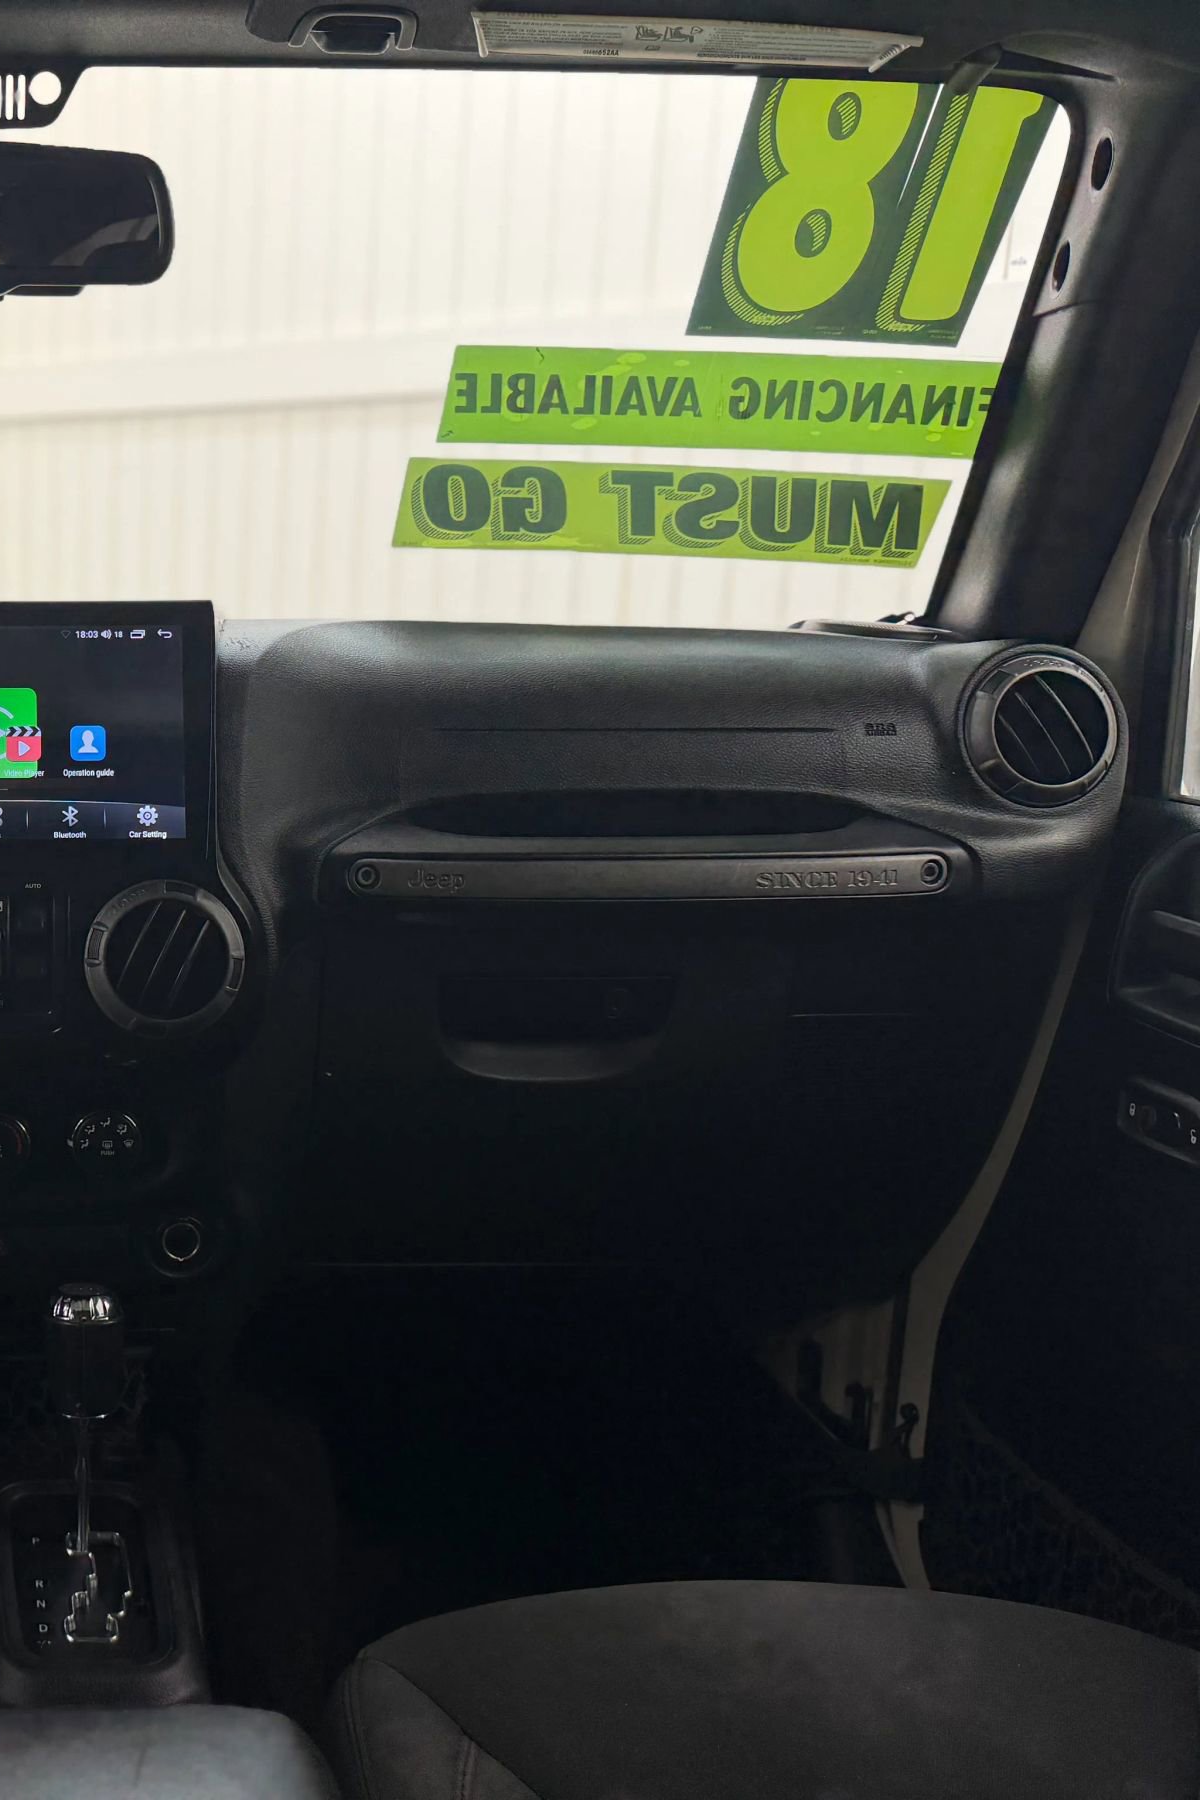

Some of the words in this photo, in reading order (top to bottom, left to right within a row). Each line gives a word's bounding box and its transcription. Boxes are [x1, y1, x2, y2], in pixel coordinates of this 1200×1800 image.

[75, 630, 98, 639] 18:03
[114, 630, 123, 638] 18
[4, 769, 23, 777] Video
[24, 769, 45, 779] Player
[63, 768, 95, 778] Operation
[96, 768, 115, 778] guide
[53, 831, 87, 839] Bluetooth
[129, 830, 141, 838] Car
[142, 830, 168, 840] Setting
[407, 868, 466, 894] Jeep
[755, 871, 839, 889] SINCE
[847, 869, 899, 888] 1941
[35, 1580, 44, 1588] R
[36, 1599, 46, 1608] N
[38, 1624, 48, 1633] D
